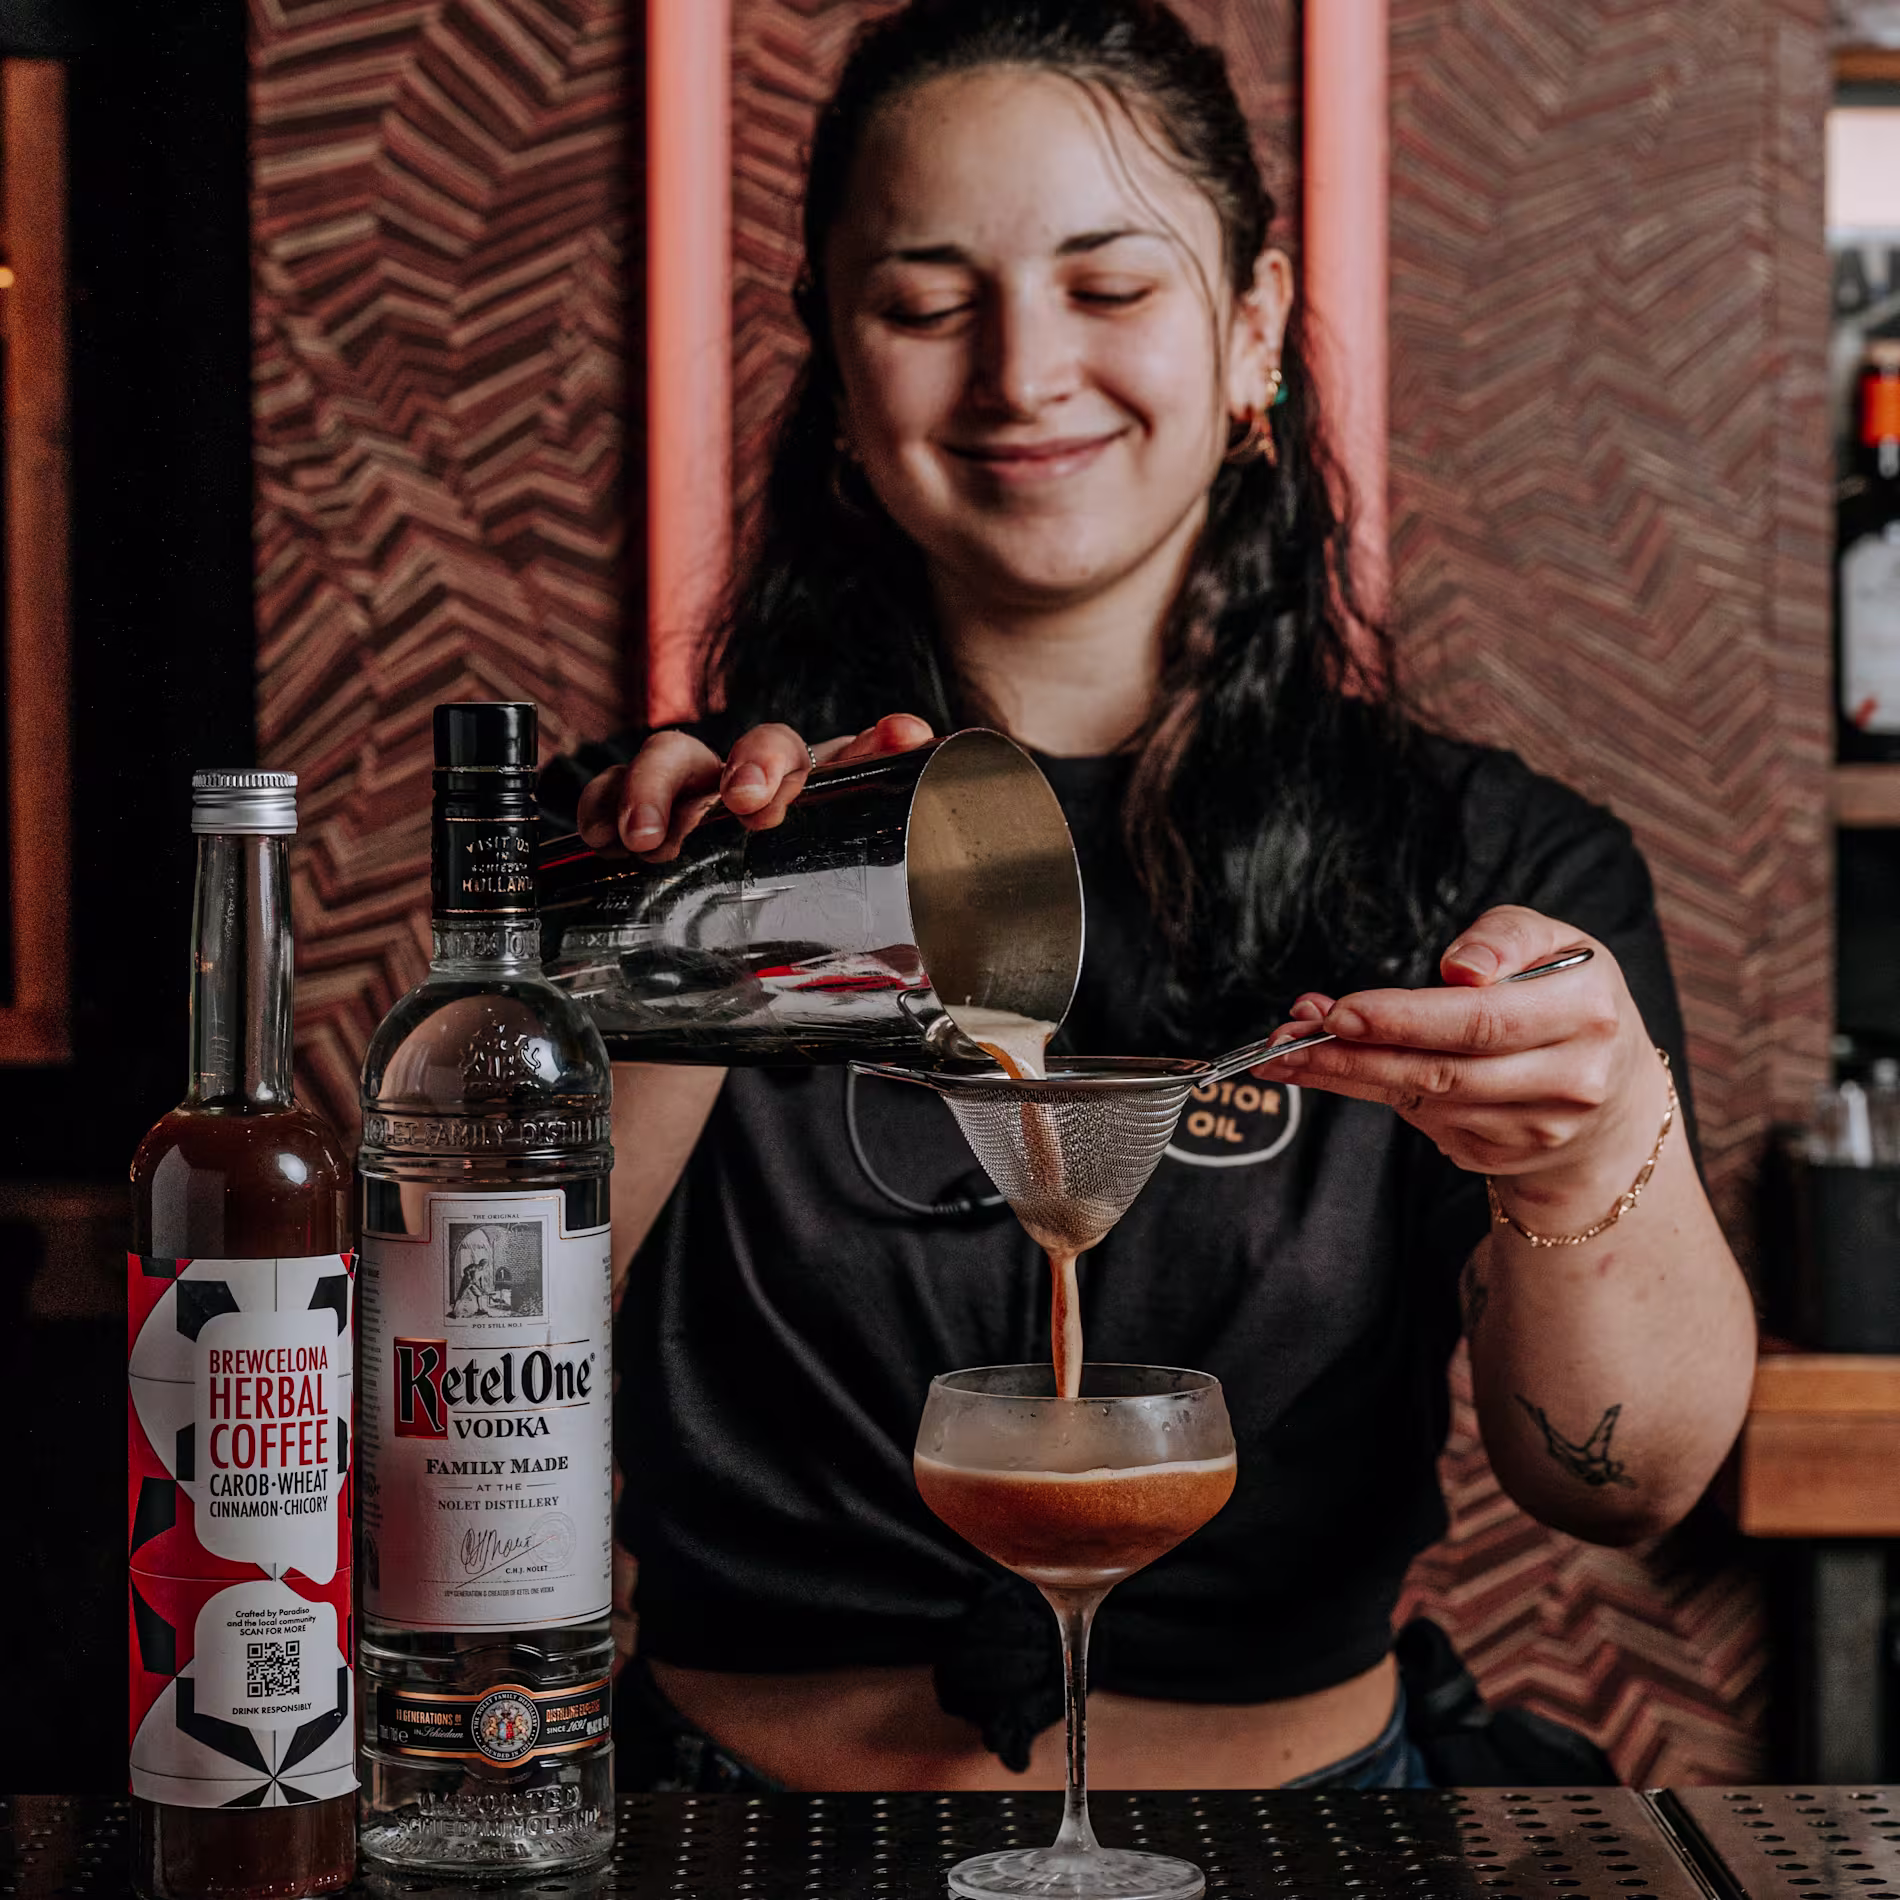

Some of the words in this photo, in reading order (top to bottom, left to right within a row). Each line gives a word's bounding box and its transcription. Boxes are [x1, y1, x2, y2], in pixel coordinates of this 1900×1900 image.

[1191, 1082, 1281, 1115] OTOR
[1187, 1111, 1244, 1143] OIL
[209, 1345, 328, 1374] BREWCELONA
[395, 1345, 518, 1432] Ketel
[209, 1373, 328, 1420] HERBAL
[453, 1416, 551, 1439] VODKA
[209, 1419, 328, 1469] COFFEE
[425, 1458, 505, 1475] FAMILY
[510, 1456, 569, 1474] MADE
[476, 1484, 492, 1492] AT
[496, 1483, 522, 1491] THE
[437, 1500, 481, 1511] NOLET
[485, 1496, 560, 1510] DISTILLERY
[235, 1610, 265, 1618] Crafted
[267, 1609, 277, 1619] by
[279, 1607, 310, 1616] Paradiso
[227, 1619, 243, 1627] and
[244, 1619, 257, 1627] the
[258, 1618, 277, 1626] local
[279, 1615, 316, 1625] community
[240, 1628, 264, 1636] SCAN
[265, 1627, 282, 1635] FOR
[284, 1624, 306, 1633] MORE
[232, 1707, 259, 1715] DRINK
[261, 1702, 312, 1713] RESPONSIBLY
[403, 1710, 453, 1726] GENERATIONS
[421, 1726, 464, 1739] Schiedam
[546, 1725, 566, 1734] SINCE
[481, 1744, 510, 1759] FOUNDED
